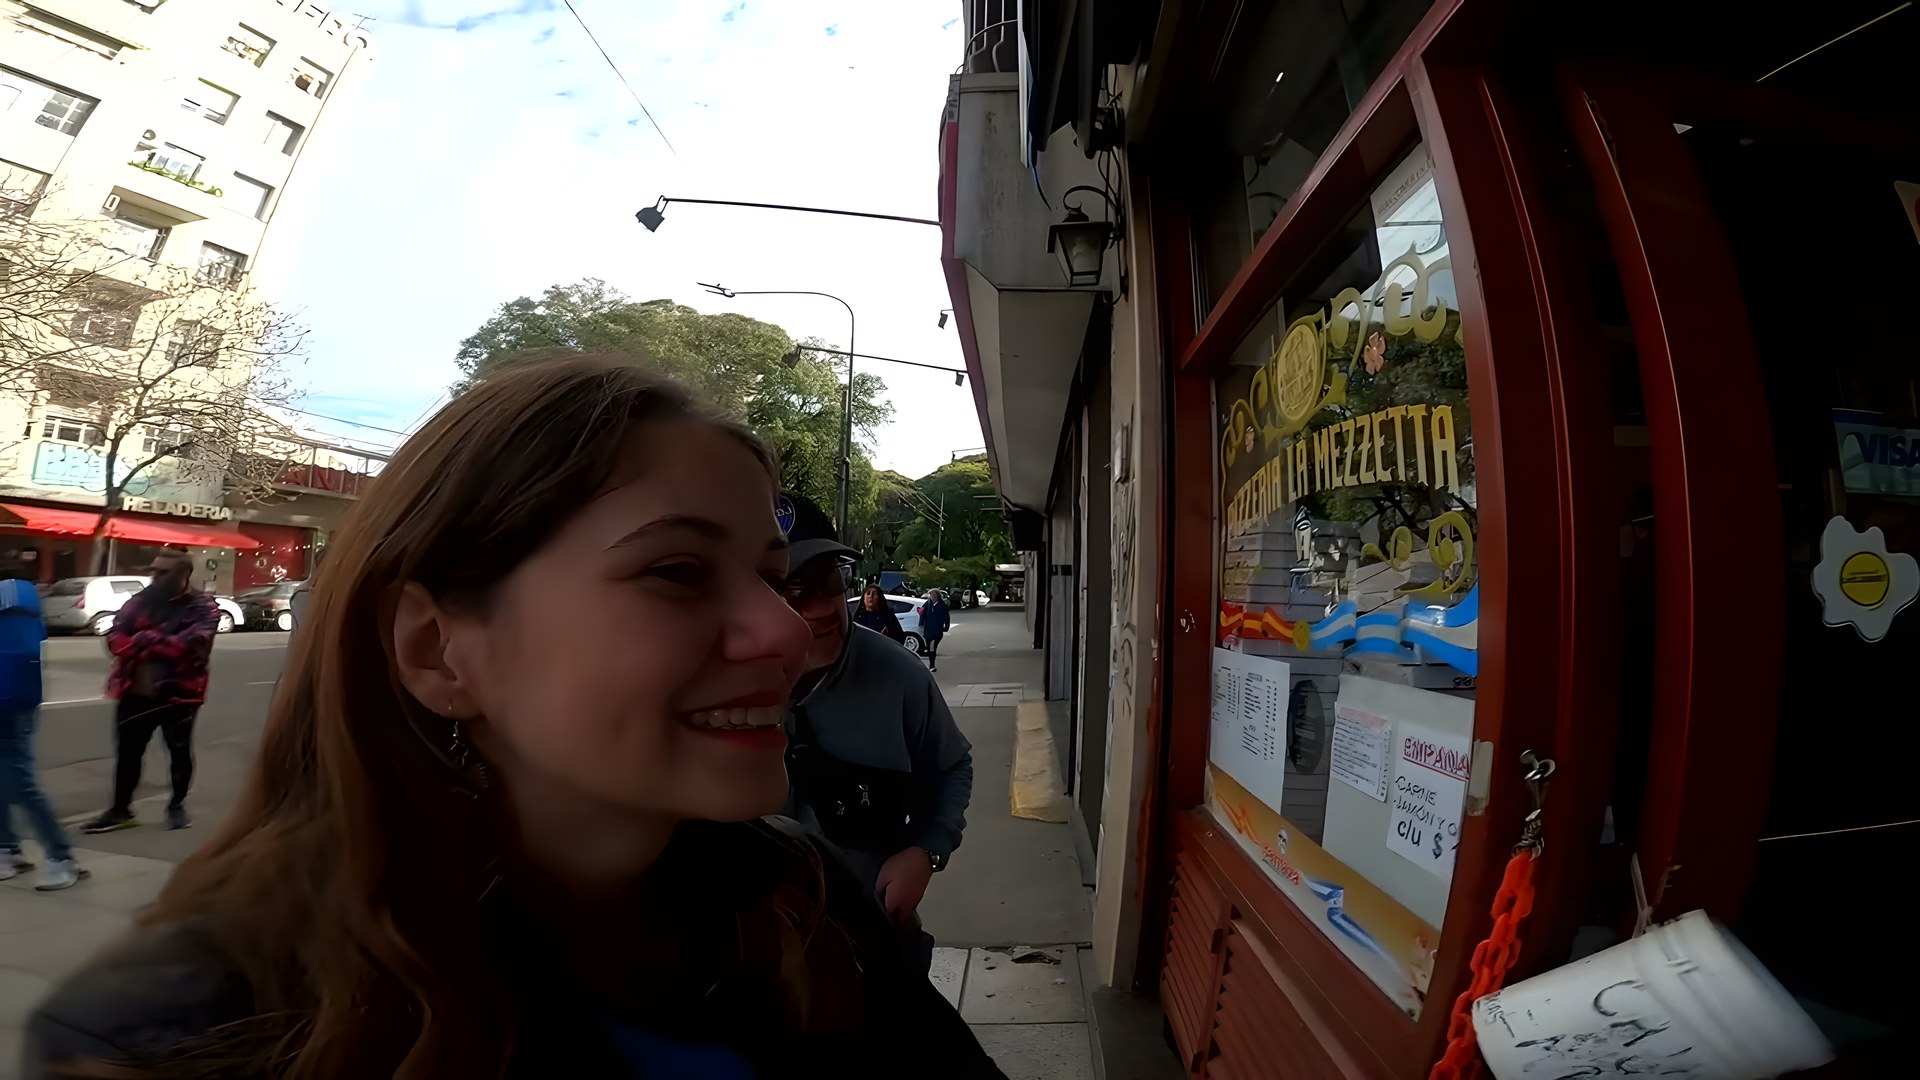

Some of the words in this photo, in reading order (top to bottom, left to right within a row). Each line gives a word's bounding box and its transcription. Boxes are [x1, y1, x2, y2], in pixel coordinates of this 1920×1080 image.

[1286, 439, 1308, 503] LA
[1313, 404, 1460, 497] MEZZETTA
[1851, 432, 1920, 468] VISA
